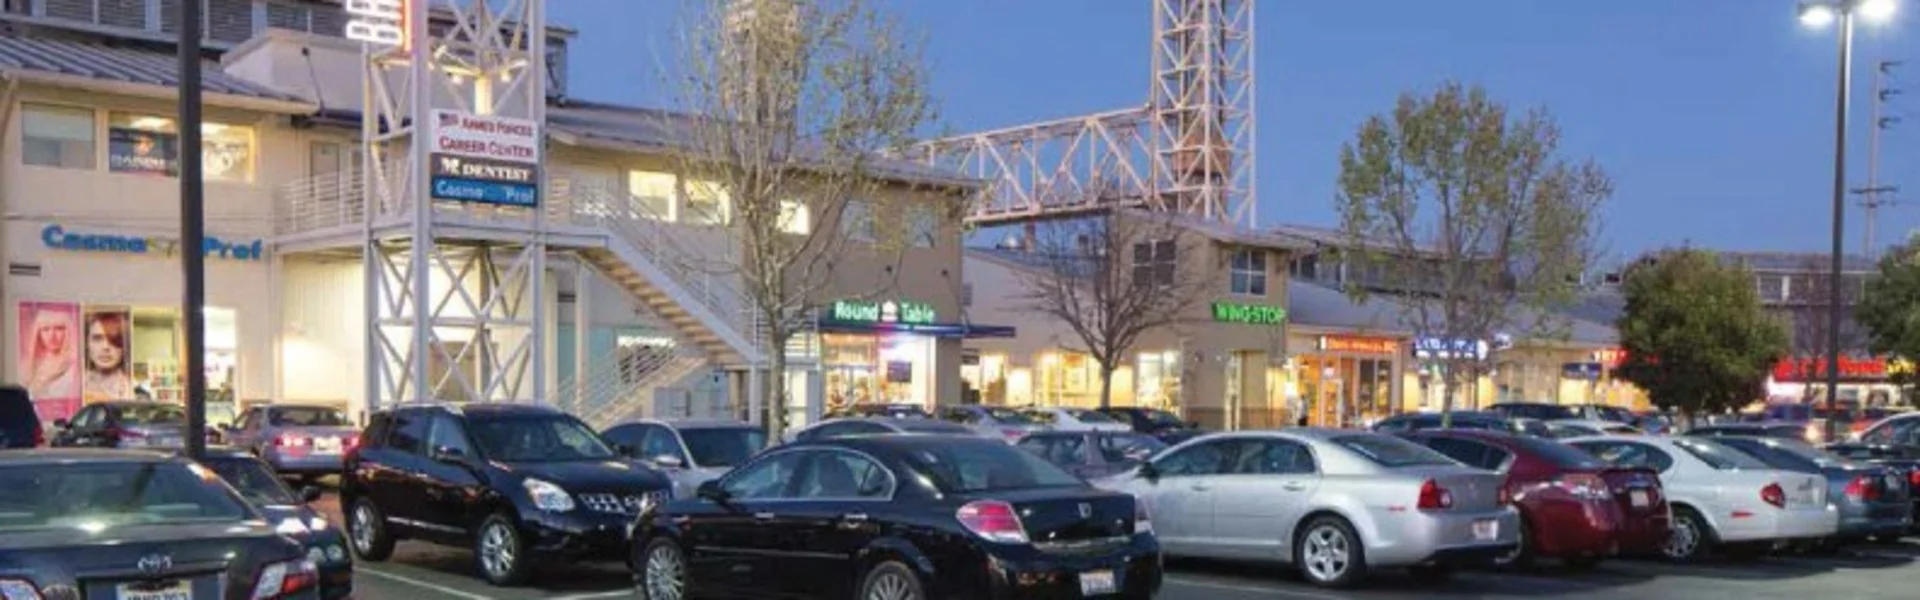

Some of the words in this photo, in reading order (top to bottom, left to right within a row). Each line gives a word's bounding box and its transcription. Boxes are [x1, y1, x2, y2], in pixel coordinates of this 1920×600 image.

[462, 118, 494, 133] ARMED
[497, 122, 533, 137] FORCES
[440, 136, 486, 152] CAREER
[489, 142, 533, 158] CENTER
[462, 163, 531, 181] DENTIST
[41, 224, 147, 253] Cosmo
[835, 301, 878, 321] Round
[901, 303, 934, 324] Table
